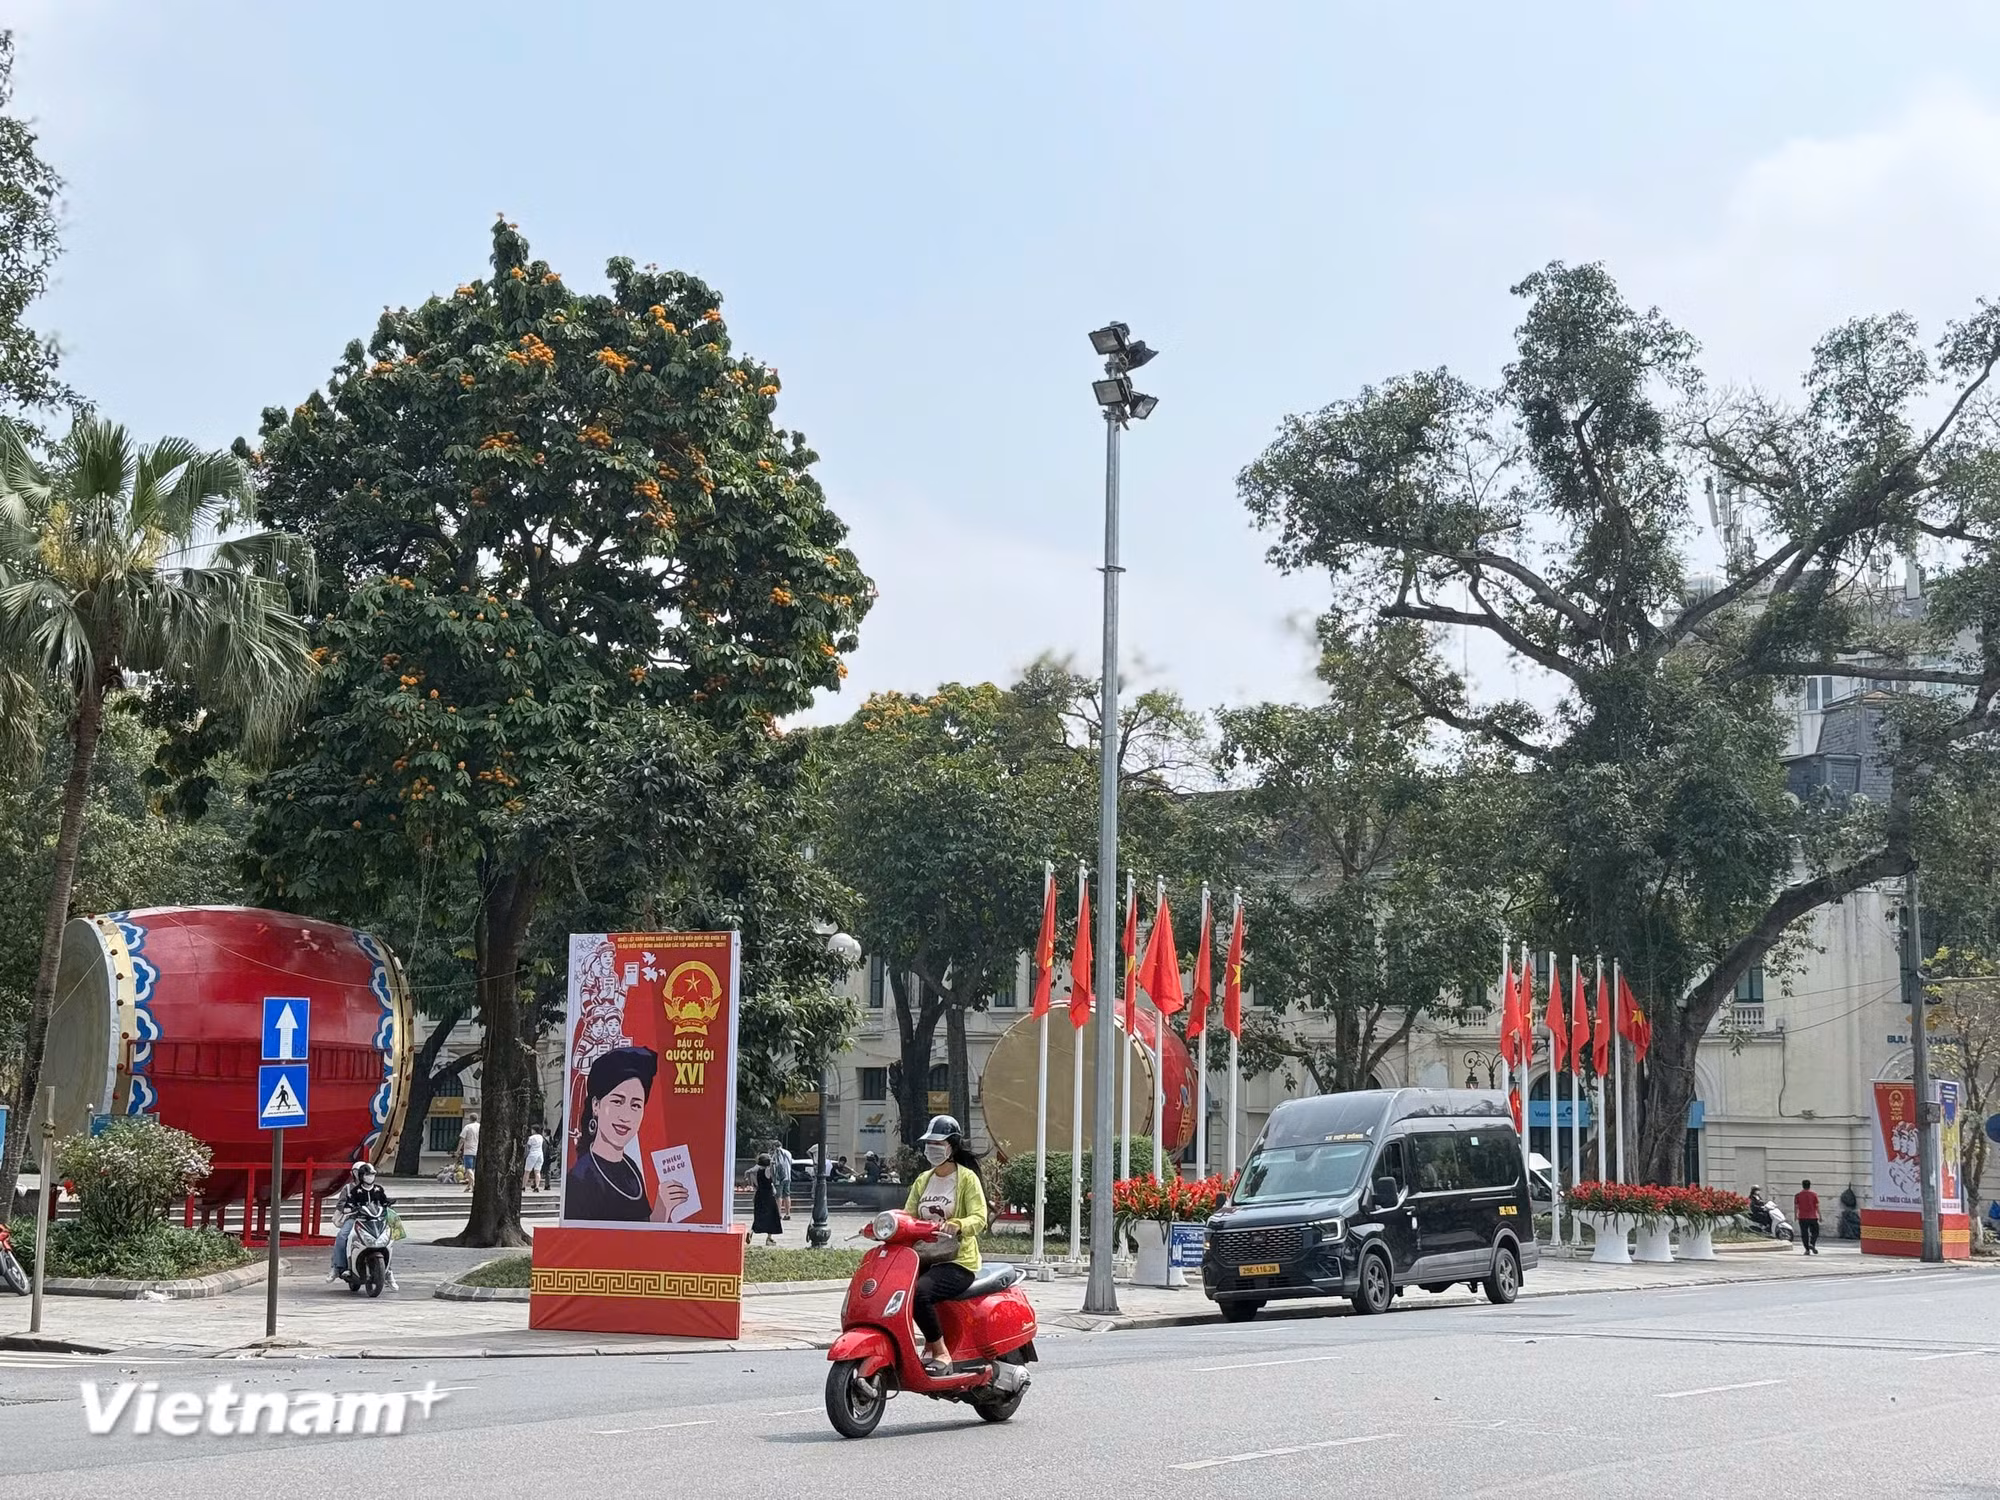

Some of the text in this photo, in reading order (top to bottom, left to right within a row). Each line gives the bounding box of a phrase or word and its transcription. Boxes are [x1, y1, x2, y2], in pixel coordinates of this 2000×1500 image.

[665, 1045, 714, 1064] QUỐC HỘI
[674, 1063, 705, 1085] XVI
